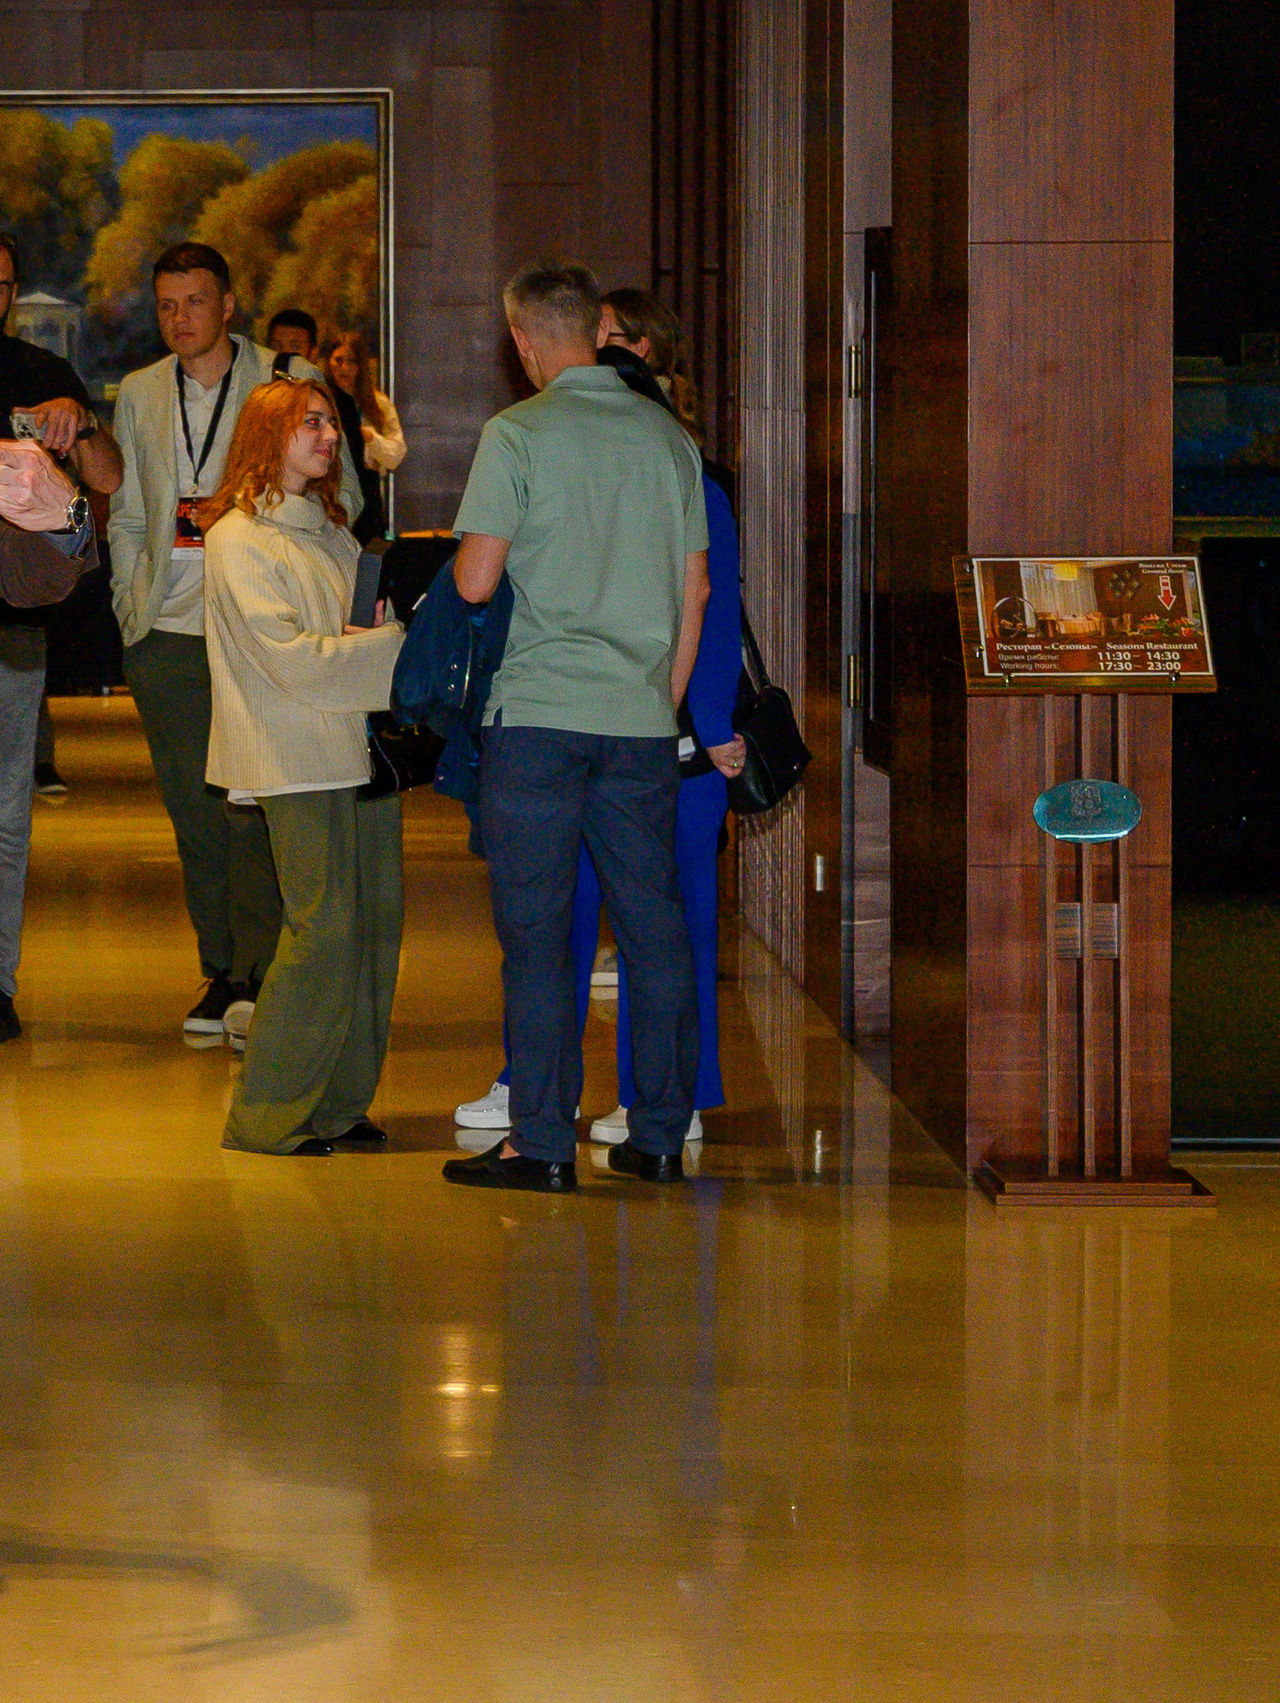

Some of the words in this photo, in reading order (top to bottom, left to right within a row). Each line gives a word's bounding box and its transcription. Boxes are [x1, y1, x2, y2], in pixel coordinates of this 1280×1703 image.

[996, 643, 1042, 653] Ресторан
[1106, 642, 1145, 650] Seasons
[1146, 642, 1199, 650] Restaurant
[998, 653, 1025, 661] Время
[1027, 653, 1060, 661] работы:
[1146, 651, 1180, 660] 14:30
[1000, 663, 1033, 671] Working
[1034, 662, 1060, 670] hours:
[1147, 661, 1181, 671] 23:00
